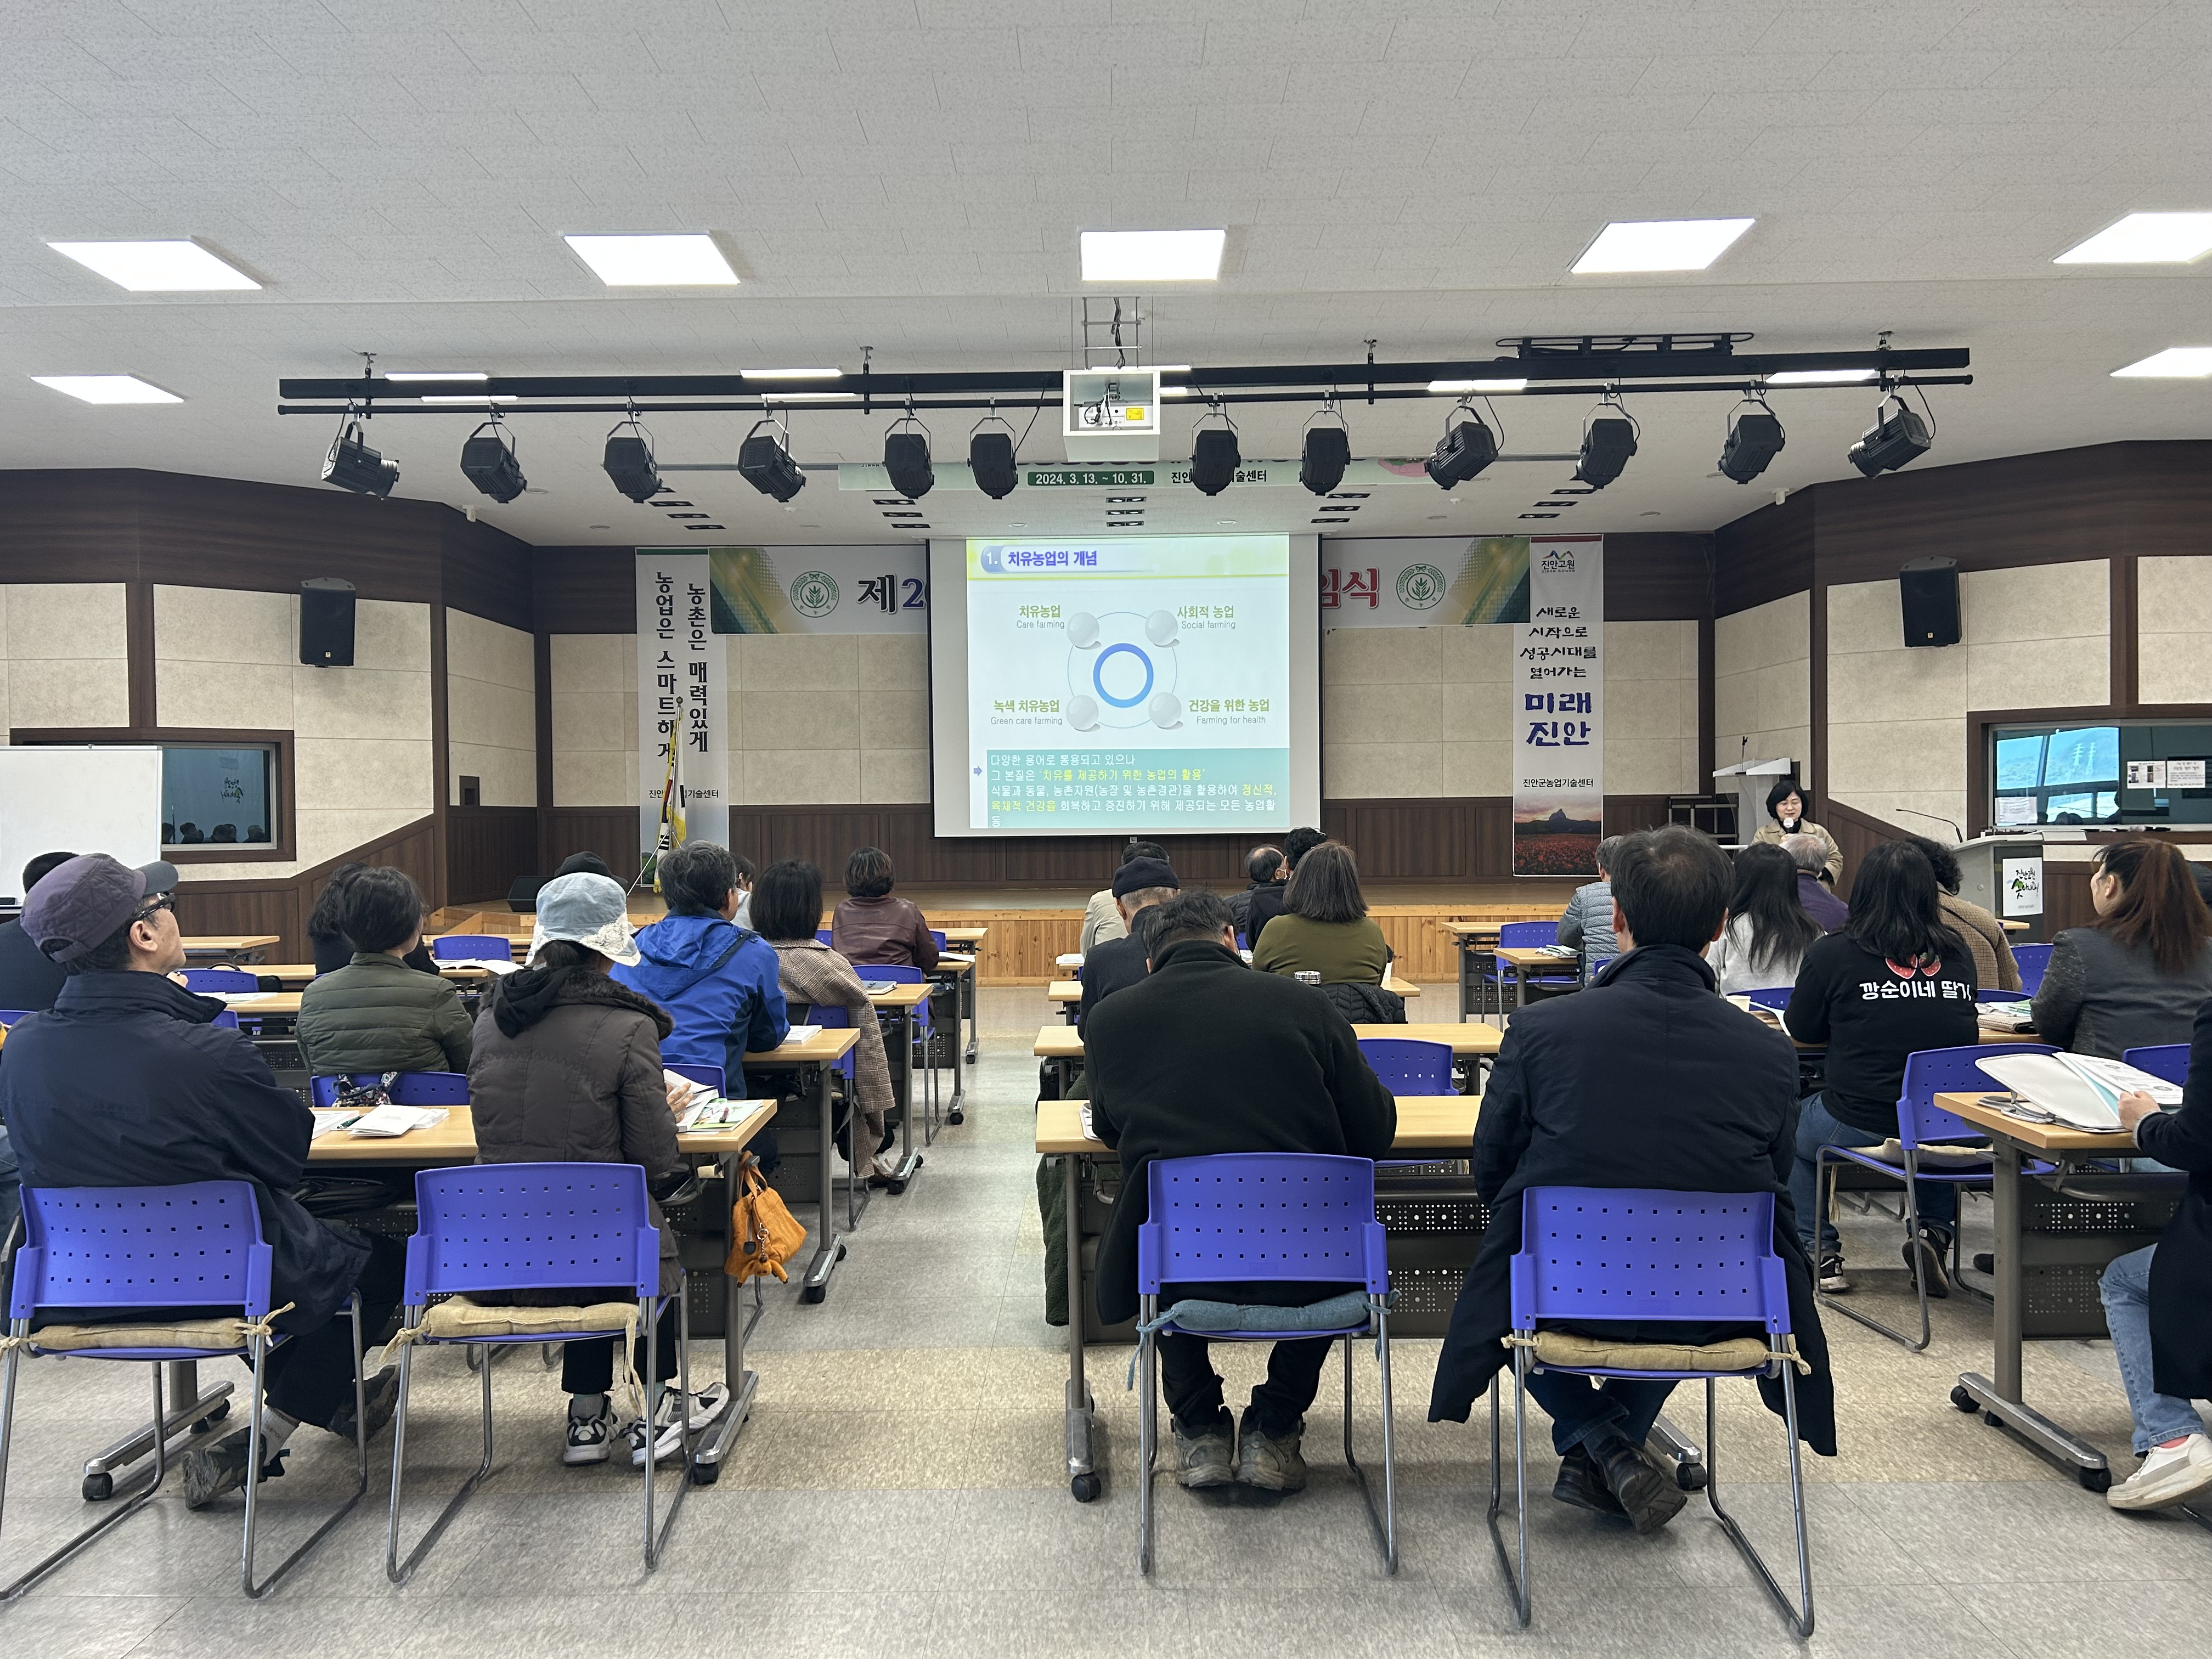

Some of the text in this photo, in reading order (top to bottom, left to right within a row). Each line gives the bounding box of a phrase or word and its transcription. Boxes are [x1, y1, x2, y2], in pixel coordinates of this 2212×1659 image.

[1036, 473, 1066, 484] 2024.
[1070, 473, 1079, 484] 3.
[1082, 472, 1097, 484] 13.
[1112, 472, 1127, 484] 10.
[1131, 472, 1146, 484] 31.
[986, 550, 1097, 566] 1. 치유농업의 개념
[1541, 560, 1575, 569] 진안고원
[655, 572, 675, 639] 농업은
[1019, 605, 1060, 618] 치유농업
[1177, 605, 1234, 619] 사회적 농업
[1536, 607, 1581, 619] 새로운
[1017, 620, 1064, 629] Care farming
[1182, 620, 1235, 630] Social farming
[1529, 627, 1588, 639] 시작으로
[1520, 646, 1597, 660] 성공시대를
[687, 583, 708, 752] 농촌은 매력있게
[1530, 667, 1587, 679] 열어가는
[994, 699, 1059, 713] 녹색 치유농업
[1189, 698, 1269, 712] 건강을 위한 농업
[1525, 692, 1592, 714] 미래
[991, 716, 1013, 725] Green
[1035, 716, 1063, 726] farming
[1197, 716, 1227, 725] Farming
[1243, 715, 1266, 724] health
[1526, 721, 1591, 746] 진안
[991, 754, 1135, 766] 다양한 용어로 통용되고 있으나
[991, 770, 1001, 781] 그
[1005, 770, 1035, 781] 본질은
[1077, 769, 1118, 781] 제공하기
[1122, 769, 1142, 781] 위한
[1147, 769, 1176, 781] 농업의
[1522, 778, 1594, 788] 진안군농업기술센터
[991, 784, 1277, 797] 식물과 동물, 농촌자원(농장 및 농촌경관)을 활용하여 정신적,
[991, 799, 1276, 812] 육체적 건강을 회복하고 증진하기 위해 제공되는 모든 농업활
[991, 815, 1001, 827] 동
[1859, 980, 1972, 1002] 깡순이네 딸기
